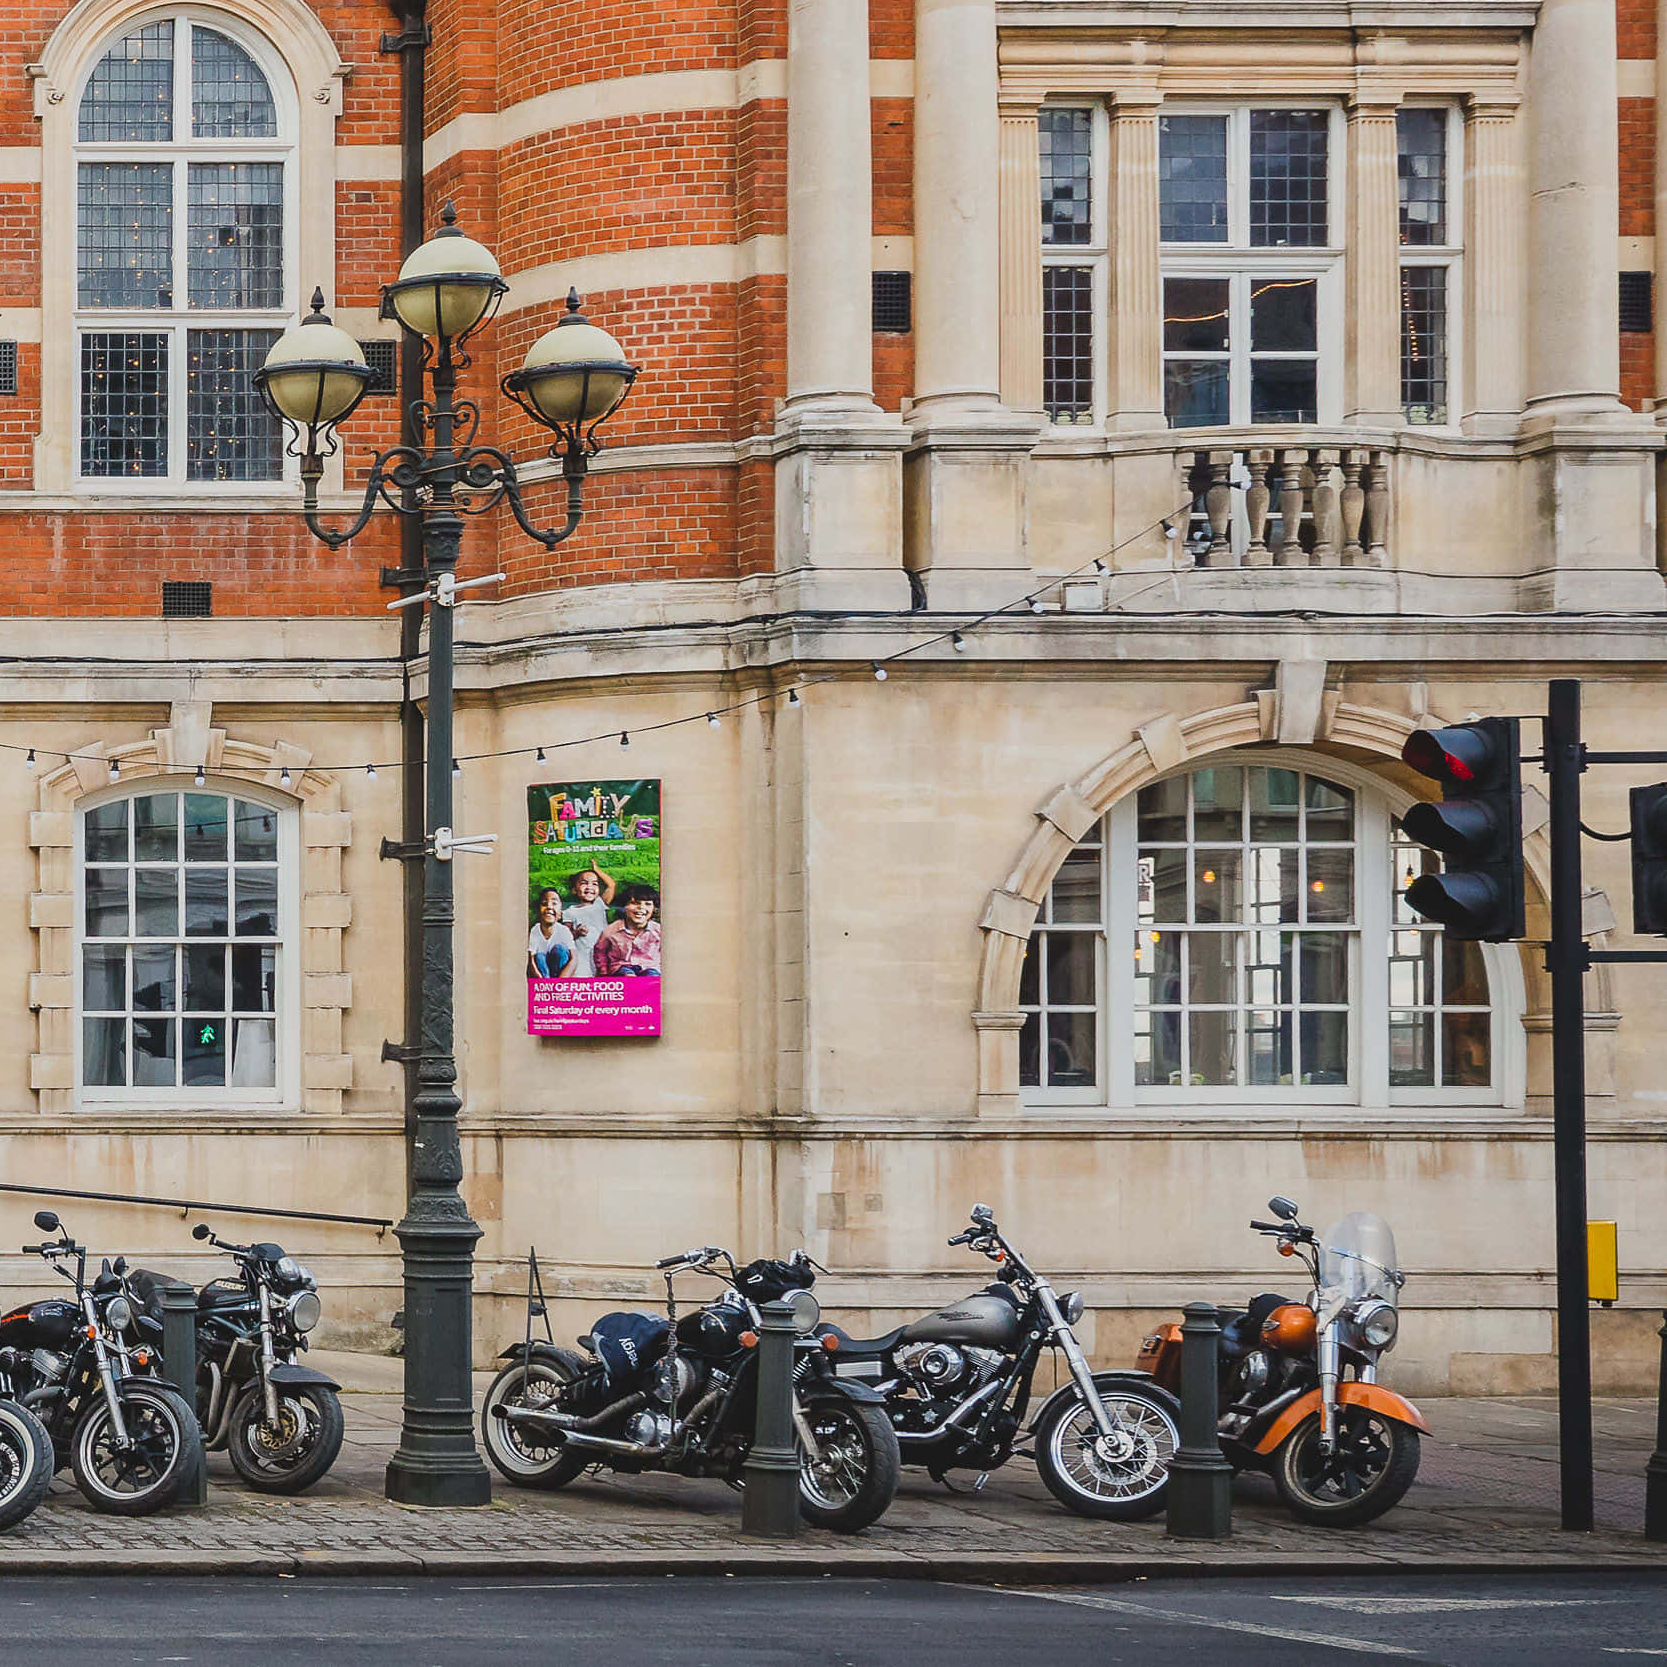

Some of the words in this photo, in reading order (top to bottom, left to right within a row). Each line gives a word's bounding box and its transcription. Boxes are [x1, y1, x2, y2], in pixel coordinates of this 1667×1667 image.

[539, 982, 555, 992] DAY
[555, 982, 570, 992] OF
[593, 981, 625, 991] FOOD
[534, 992, 551, 1002] AND
[551, 992, 572, 1002] FREE
[572, 991, 625, 1001] ACTIVITIES
[549, 1005, 583, 1016] Saturday
[584, 1005, 594, 1014] of
[594, 1006, 620, 1016] every
[620, 1004, 653, 1014] month
